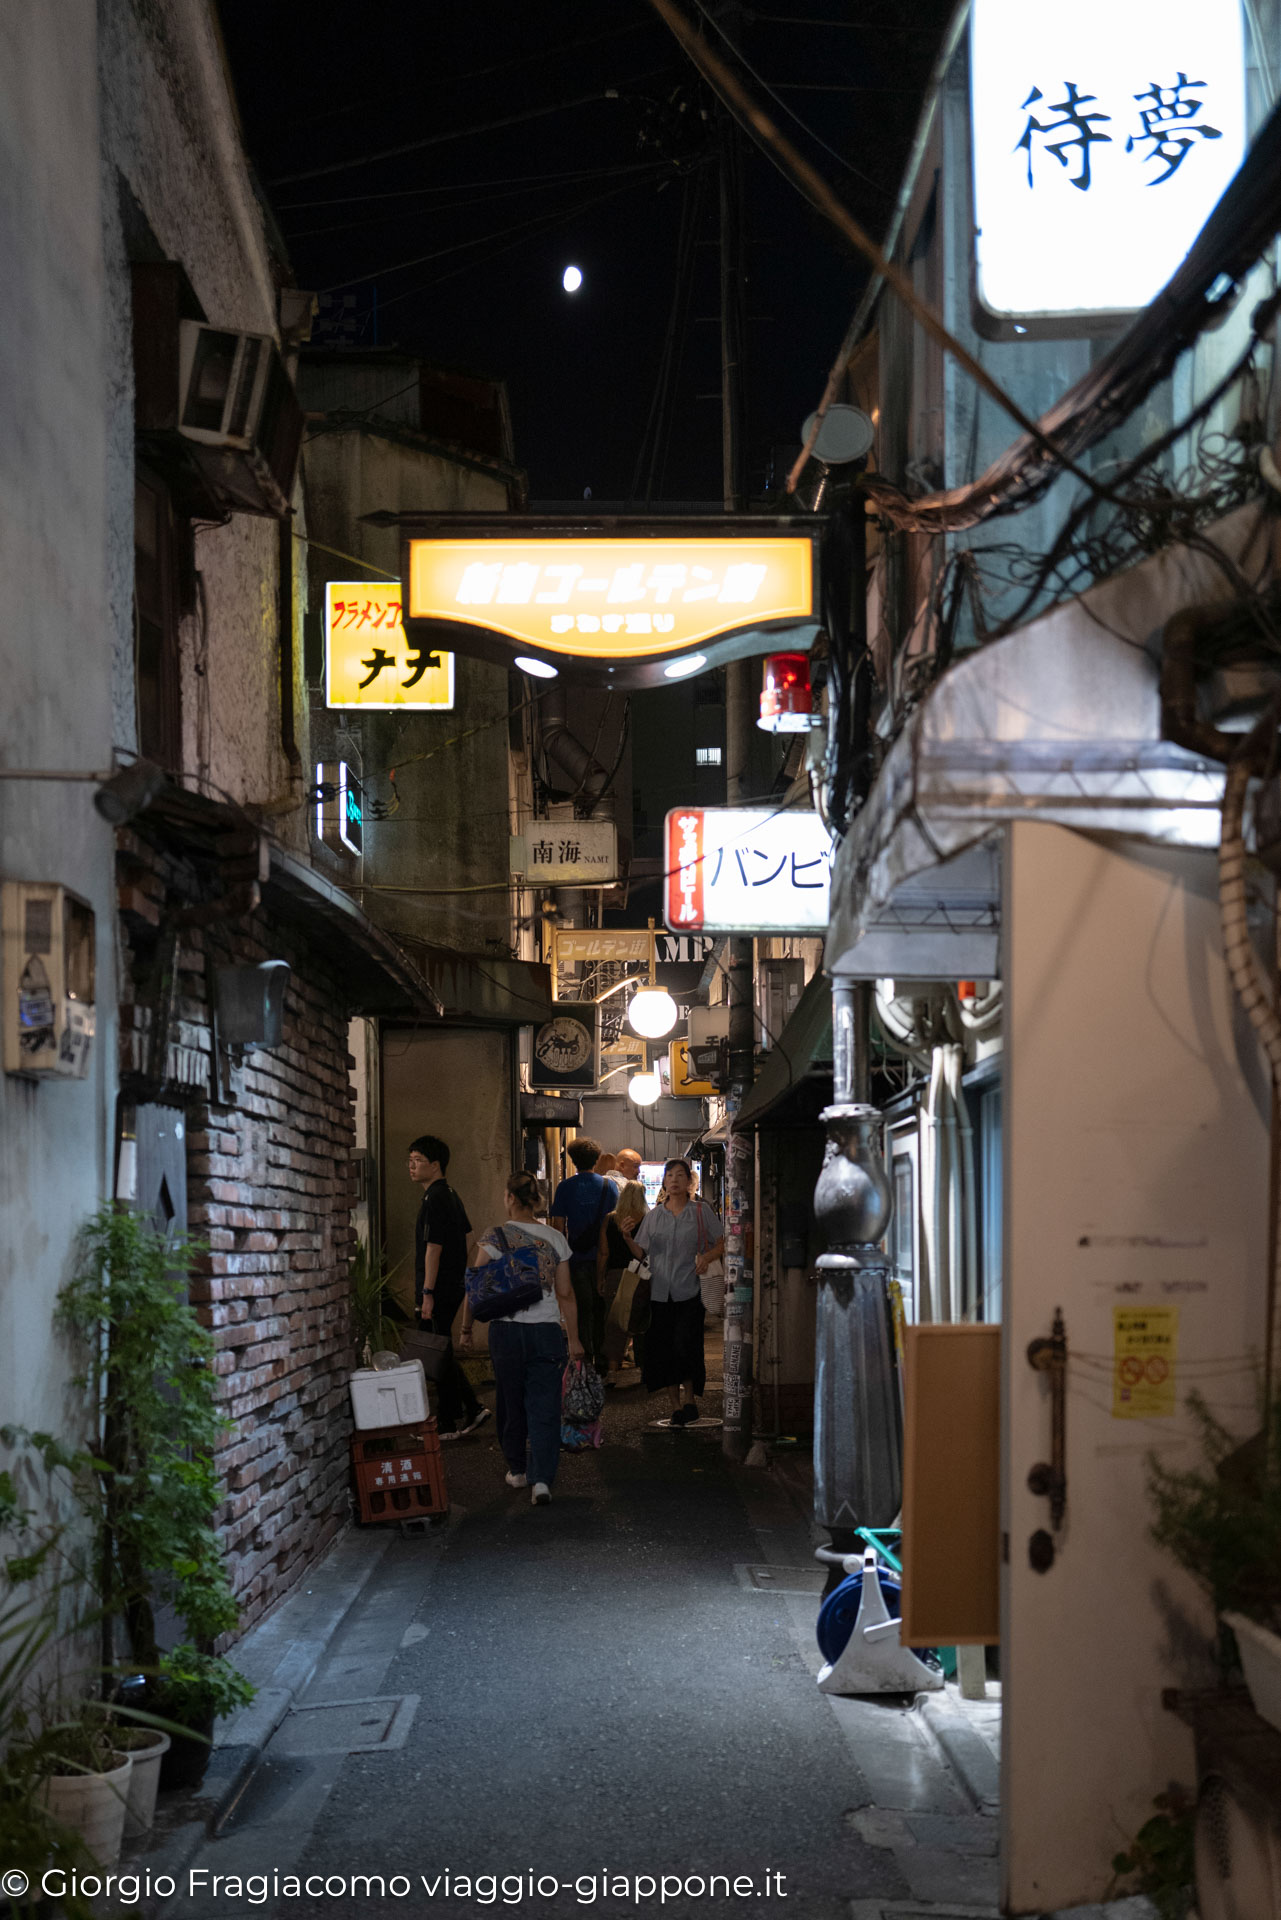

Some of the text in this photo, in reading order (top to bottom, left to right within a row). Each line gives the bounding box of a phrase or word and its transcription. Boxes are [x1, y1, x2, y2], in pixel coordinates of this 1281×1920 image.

[1011, 71, 1223, 191] 待夢
[359, 647, 441, 689] ナナ
[532, 840, 609, 864] 南海 NAMI
[711, 847, 828, 888] バンビ
[559, 938, 647, 957] ゴールデン街
